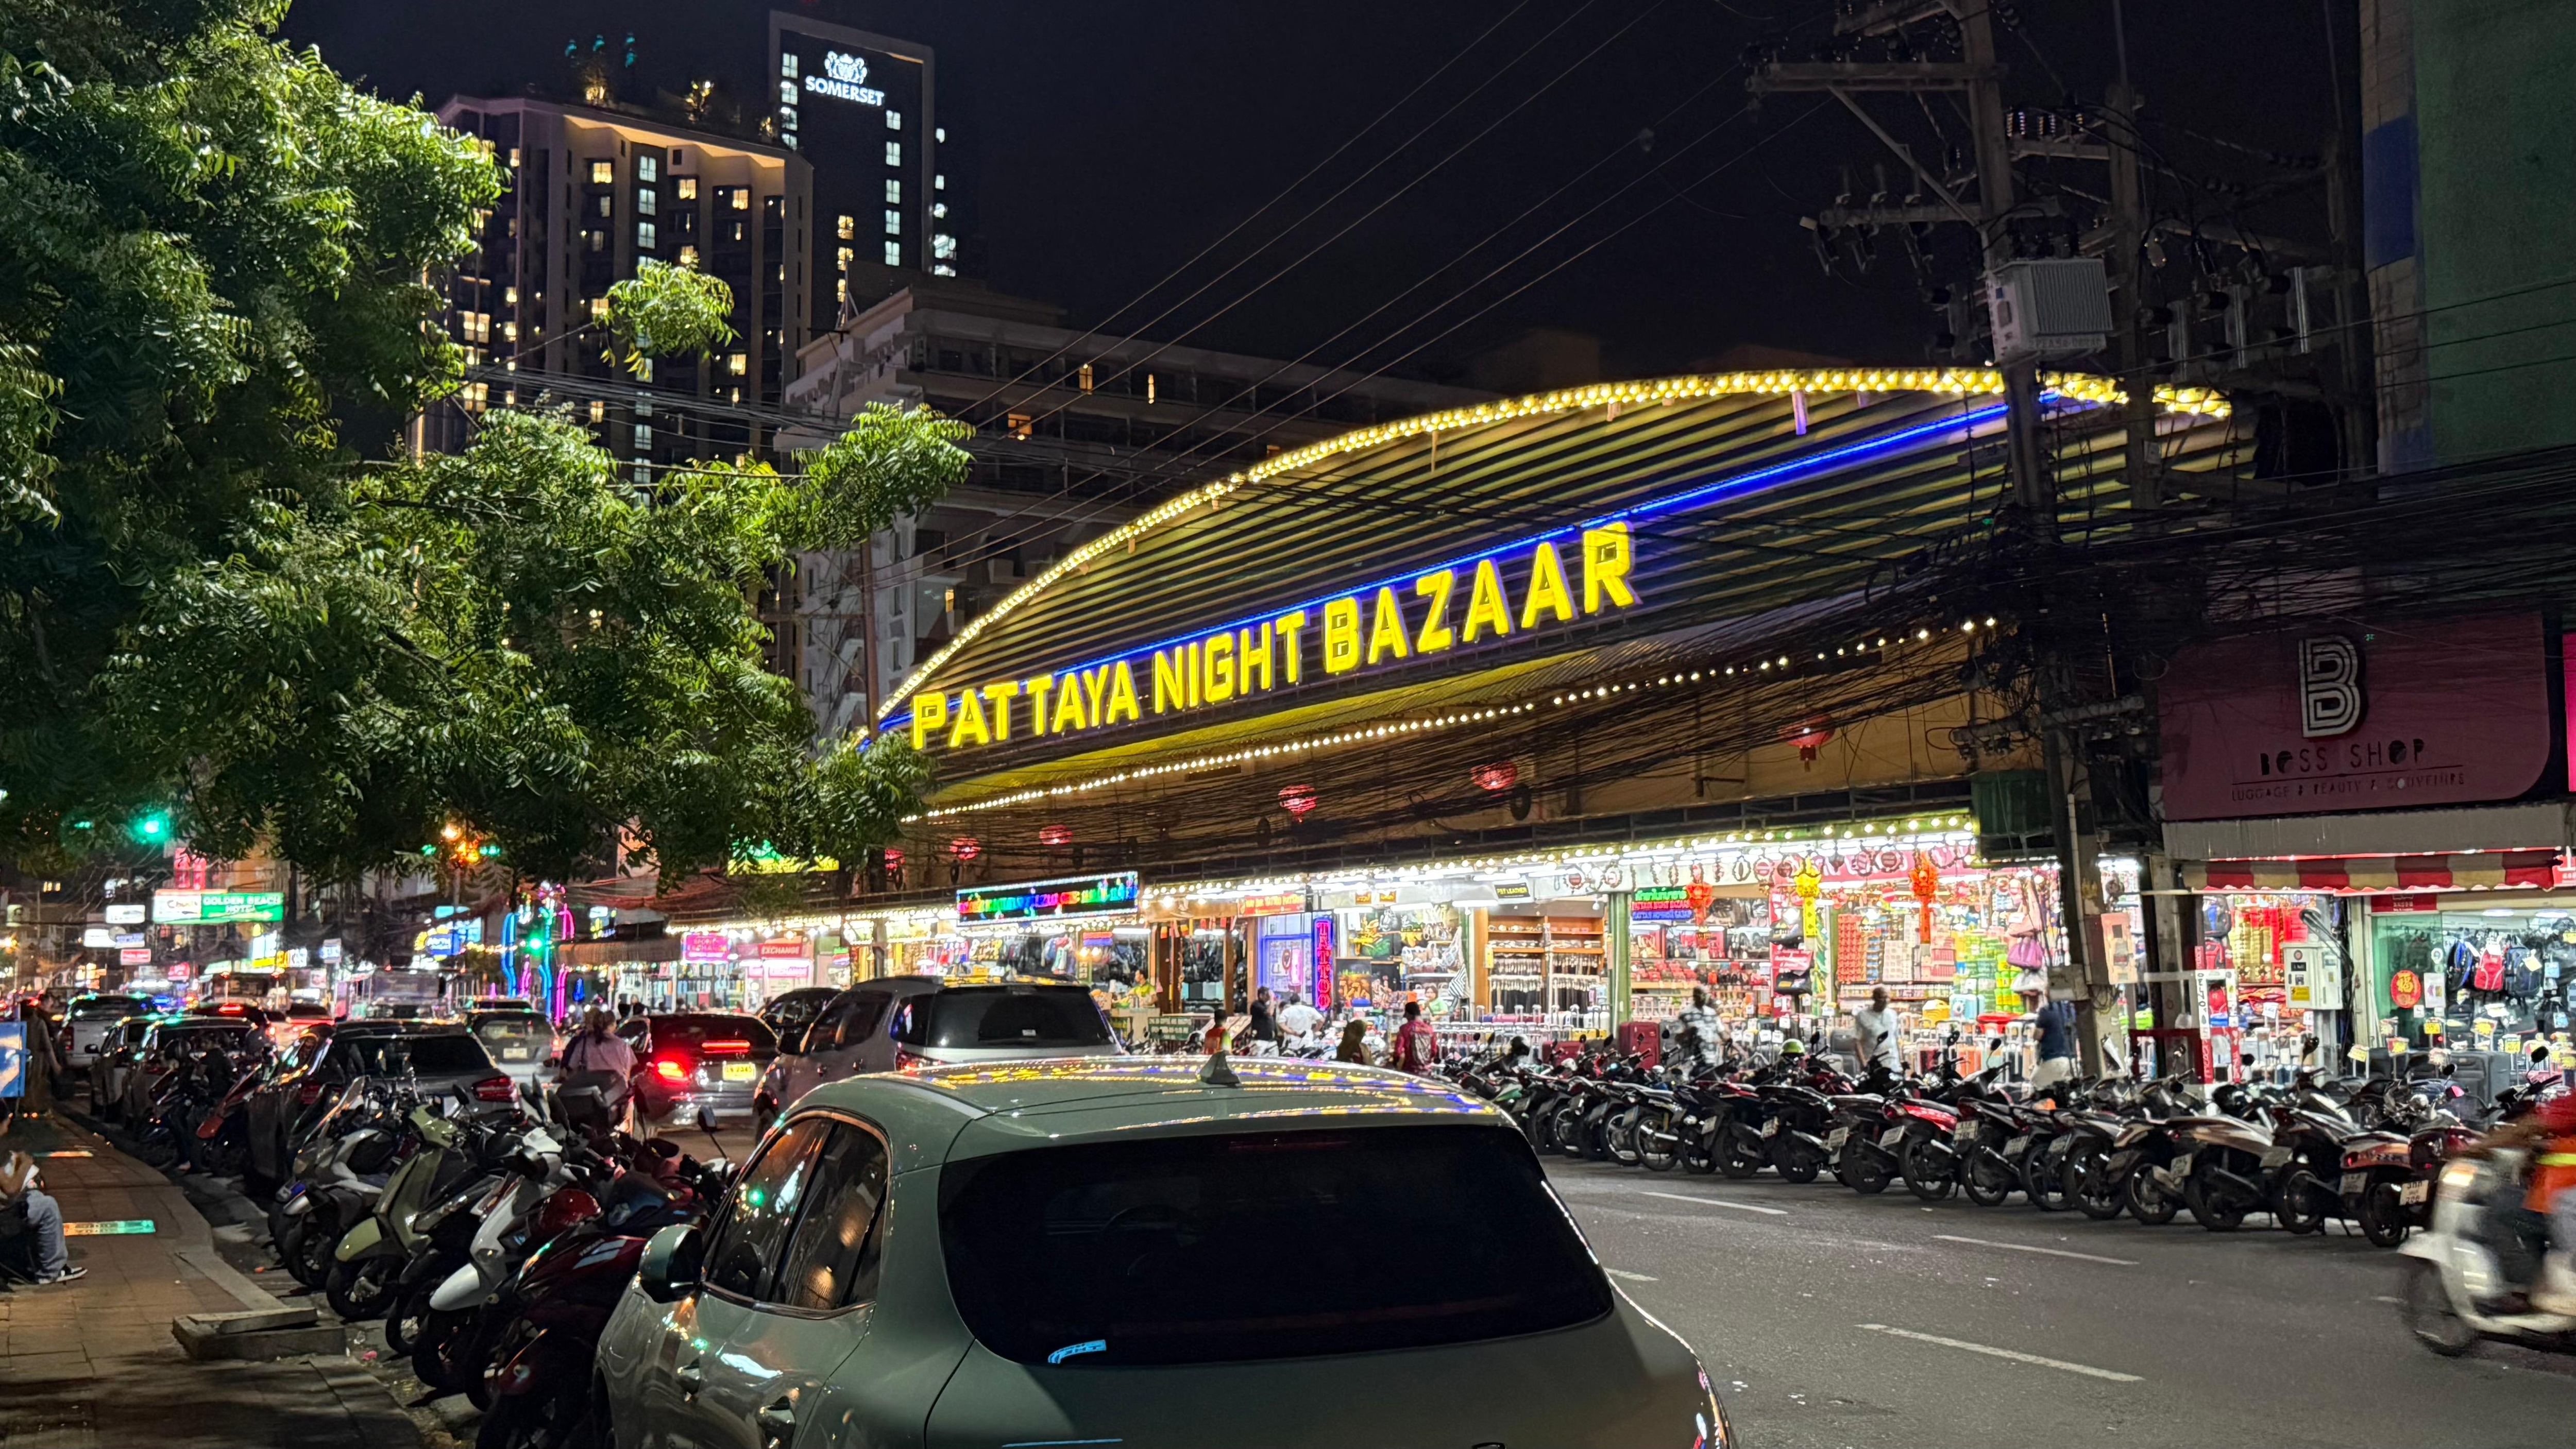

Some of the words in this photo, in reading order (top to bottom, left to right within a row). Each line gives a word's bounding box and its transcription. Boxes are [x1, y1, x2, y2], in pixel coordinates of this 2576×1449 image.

[805, 75, 885, 106] SOMERSET
[911, 660, 1139, 749] PATTAYA
[1155, 610, 1305, 714] NIGHT
[1325, 520, 1634, 673] BAZAAR
[2298, 634, 2361, 738] B
[2350, 738, 2425, 768] SHOP
[760, 945, 801, 956] EXCHANGE
[1316, 922, 1332, 1009] TATTOO
